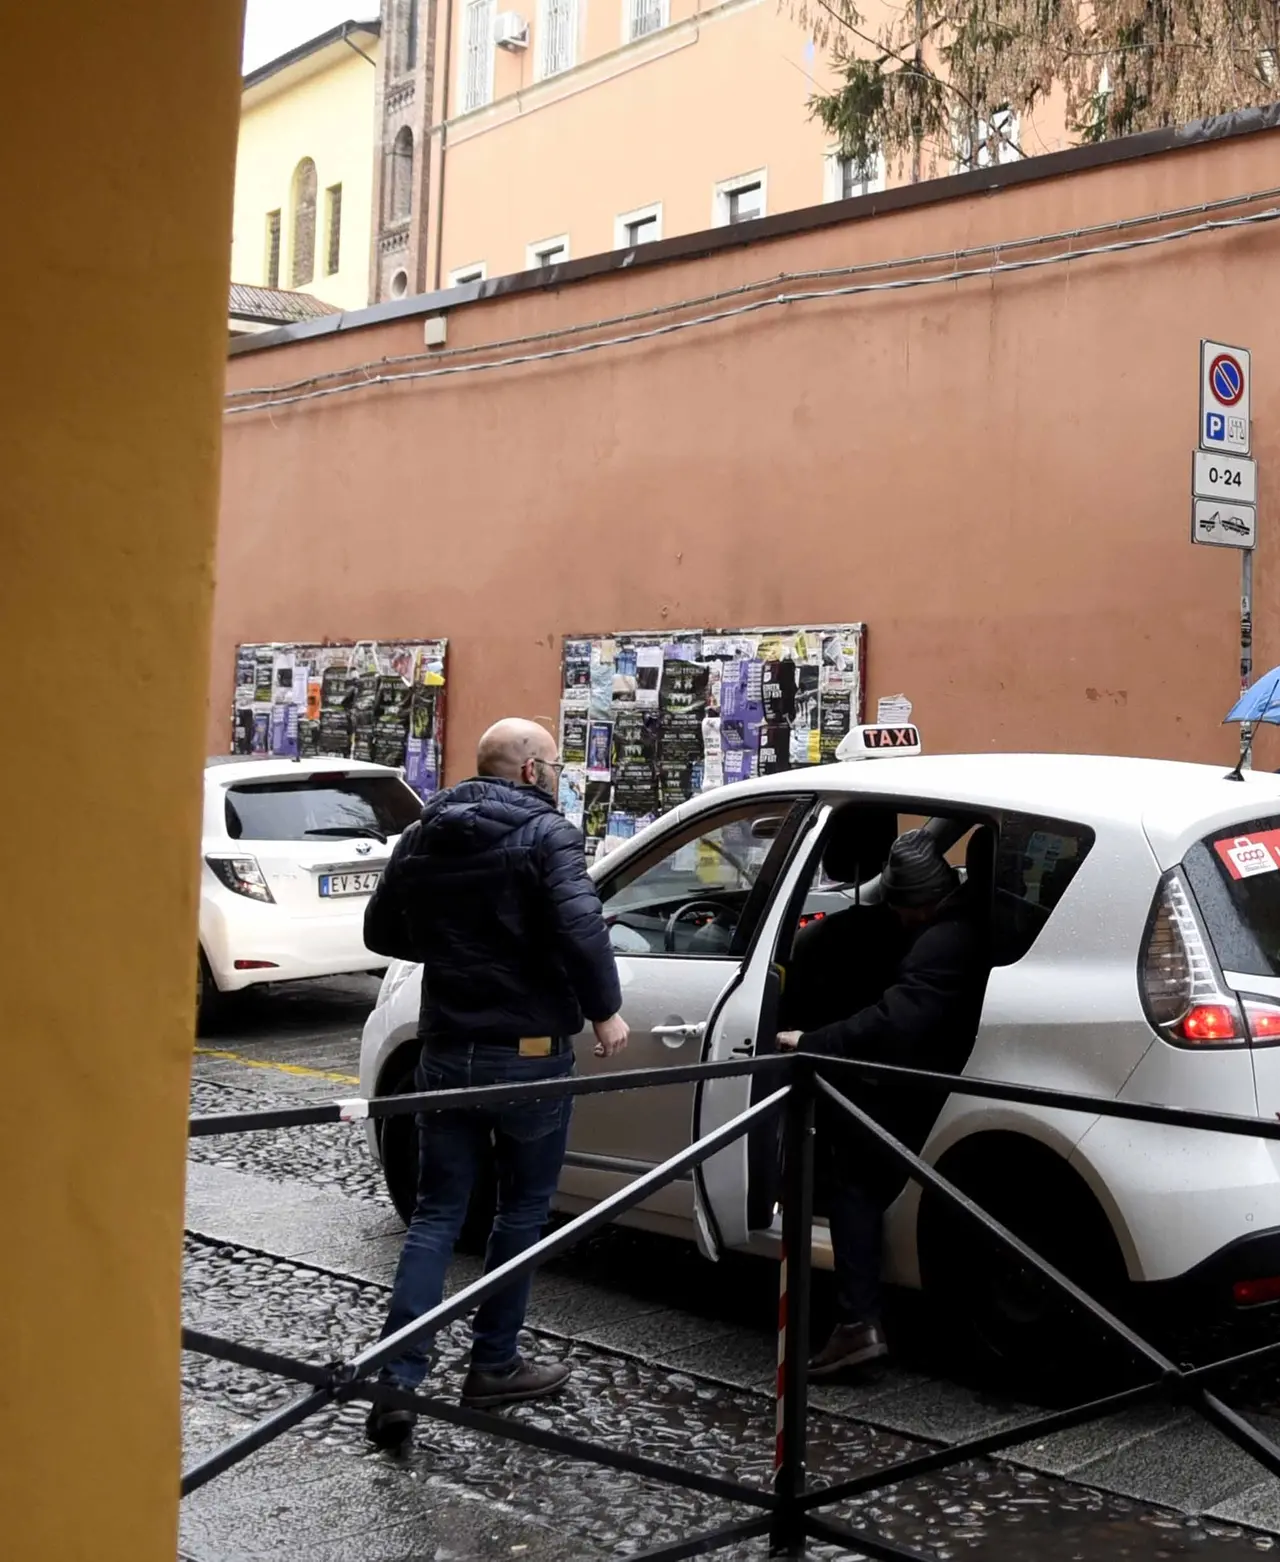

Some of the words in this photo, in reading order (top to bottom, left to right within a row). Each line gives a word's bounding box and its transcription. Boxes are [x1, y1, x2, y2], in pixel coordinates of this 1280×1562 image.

[1210, 416, 1222, 437] P
[1209, 467, 1242, 487] 0-24
[865, 729, 915, 747] TAXI
[1237, 848, 1264, 862] coop
